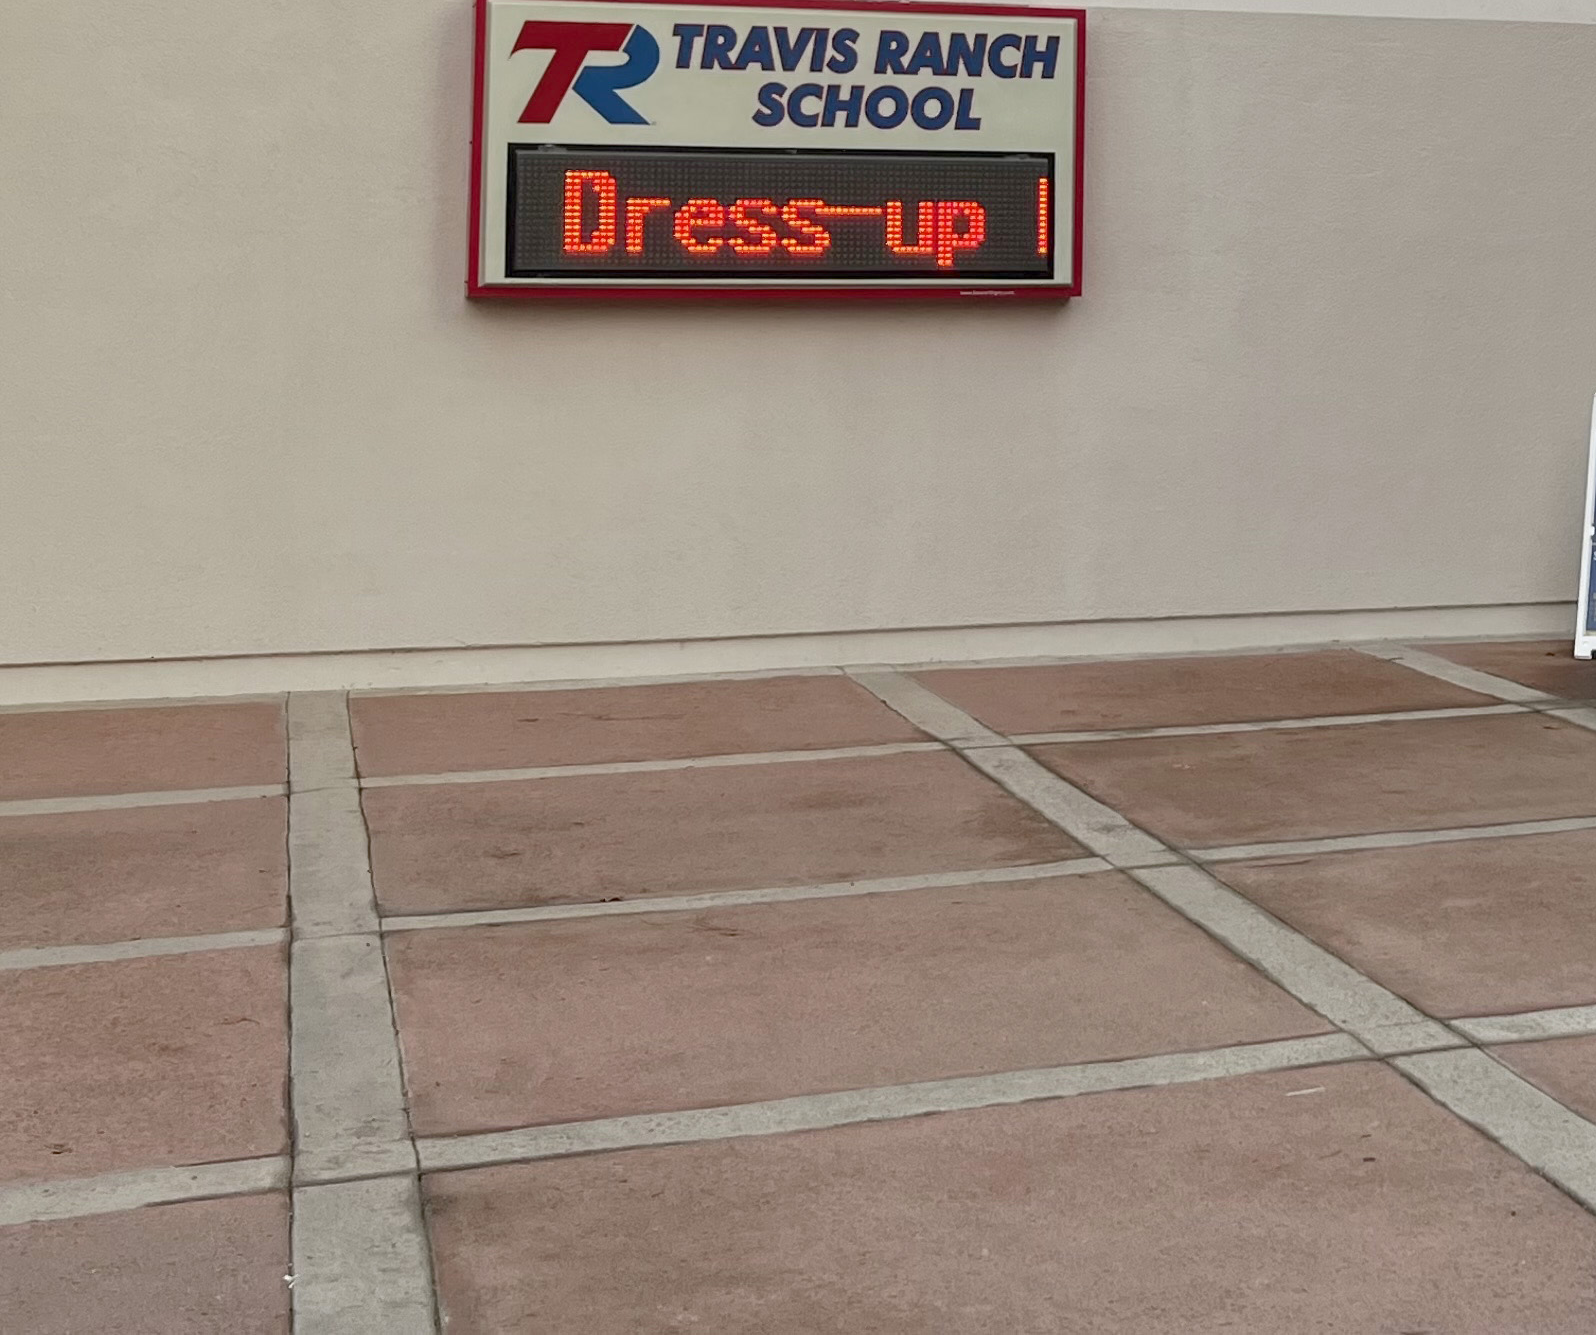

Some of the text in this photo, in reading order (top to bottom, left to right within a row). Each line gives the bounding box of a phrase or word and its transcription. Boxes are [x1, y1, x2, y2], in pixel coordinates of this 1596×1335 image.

[672, 23, 1060, 79] TRAVIS RANCH
[751, 82, 981, 131] SCHOOL
[562, 169, 986, 270] Dress-up
